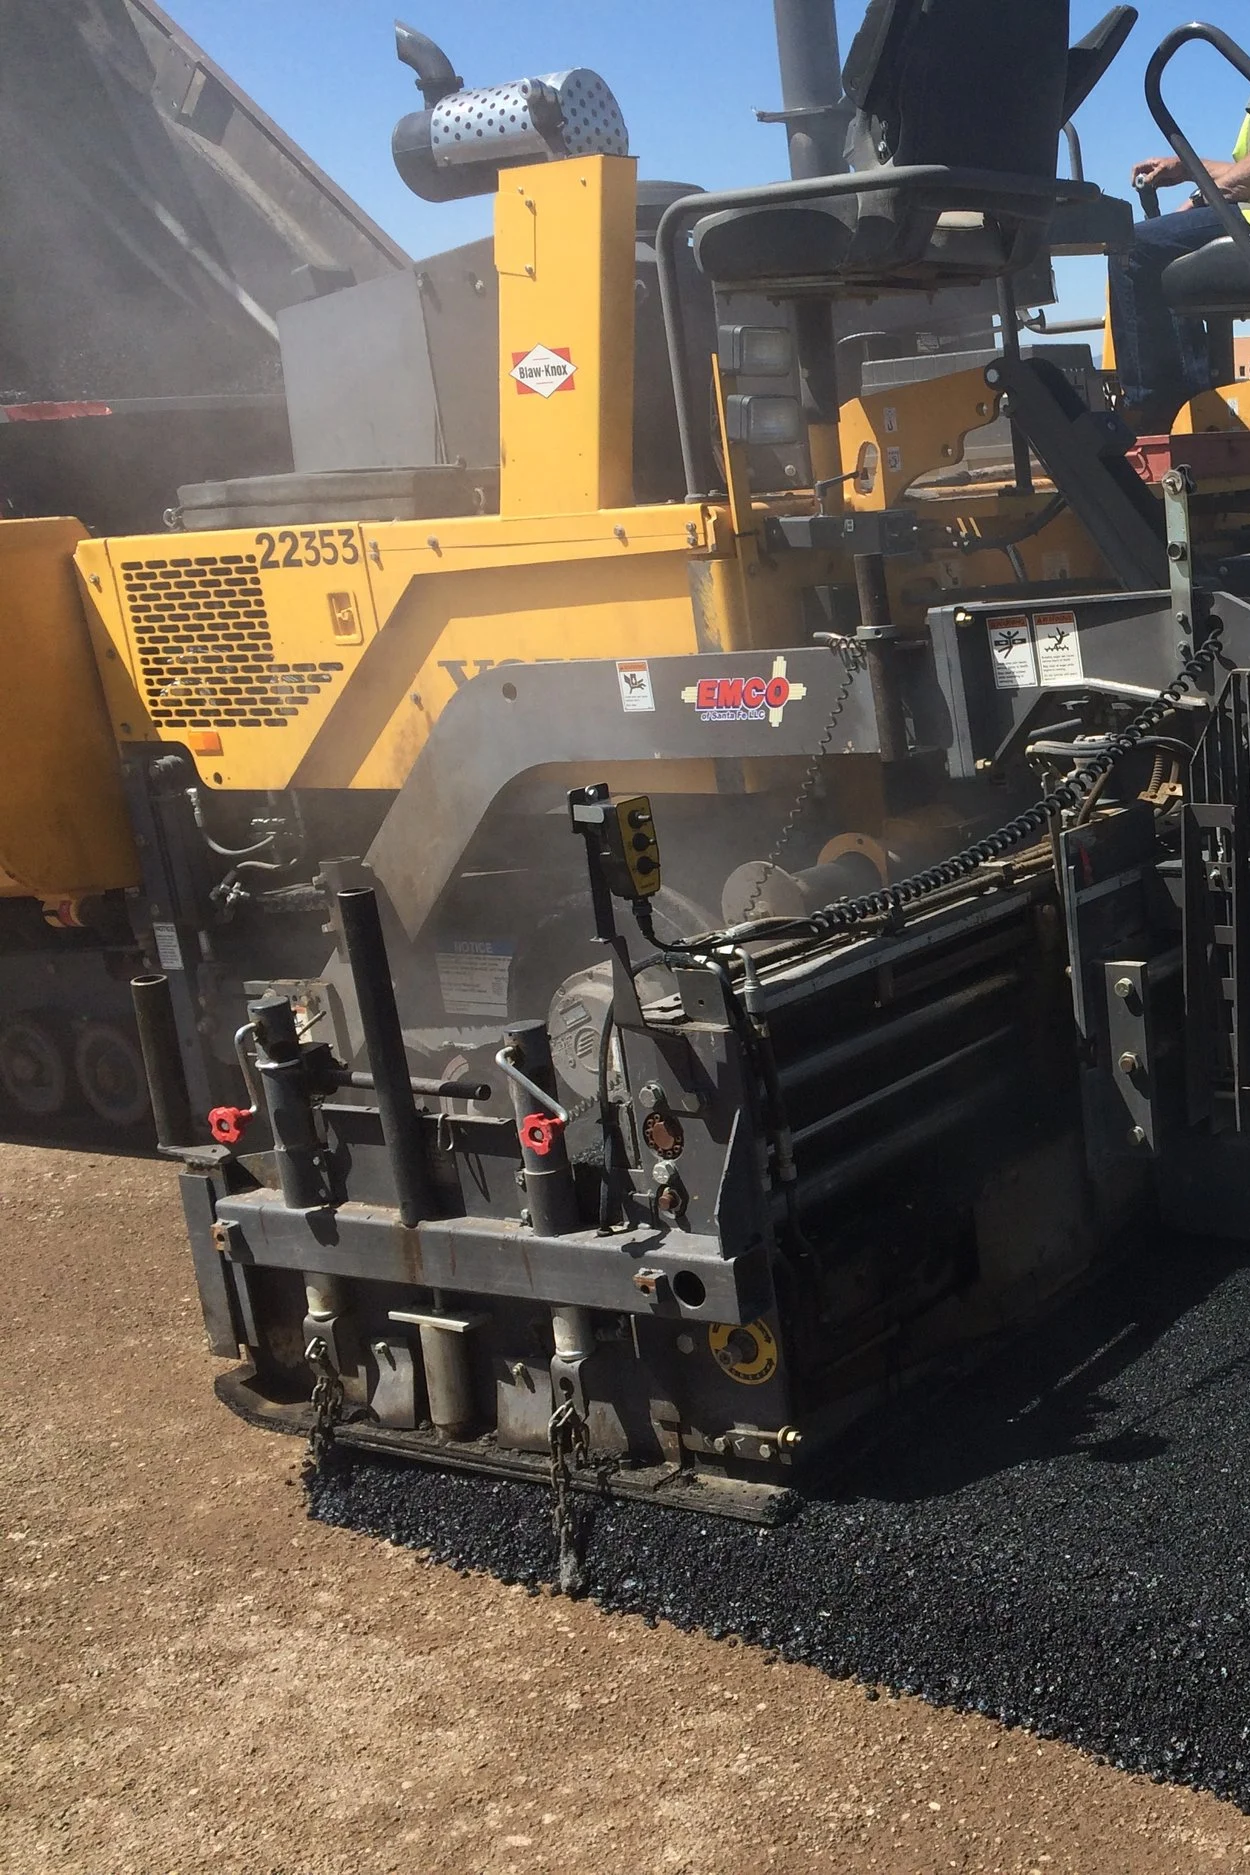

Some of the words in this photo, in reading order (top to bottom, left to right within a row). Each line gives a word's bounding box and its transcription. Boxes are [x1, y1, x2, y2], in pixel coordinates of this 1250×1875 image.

[518, 364, 568, 379] Blaw-Knox
[255, 528, 359, 570] 22353
[696, 676, 790, 709] EMCO
[701, 711, 710, 721] of
[711, 711, 735, 720] Santa
[736, 710, 747, 720] Fe
[749, 710, 766, 719] LLC
[453, 940, 494, 954] NOTICE
